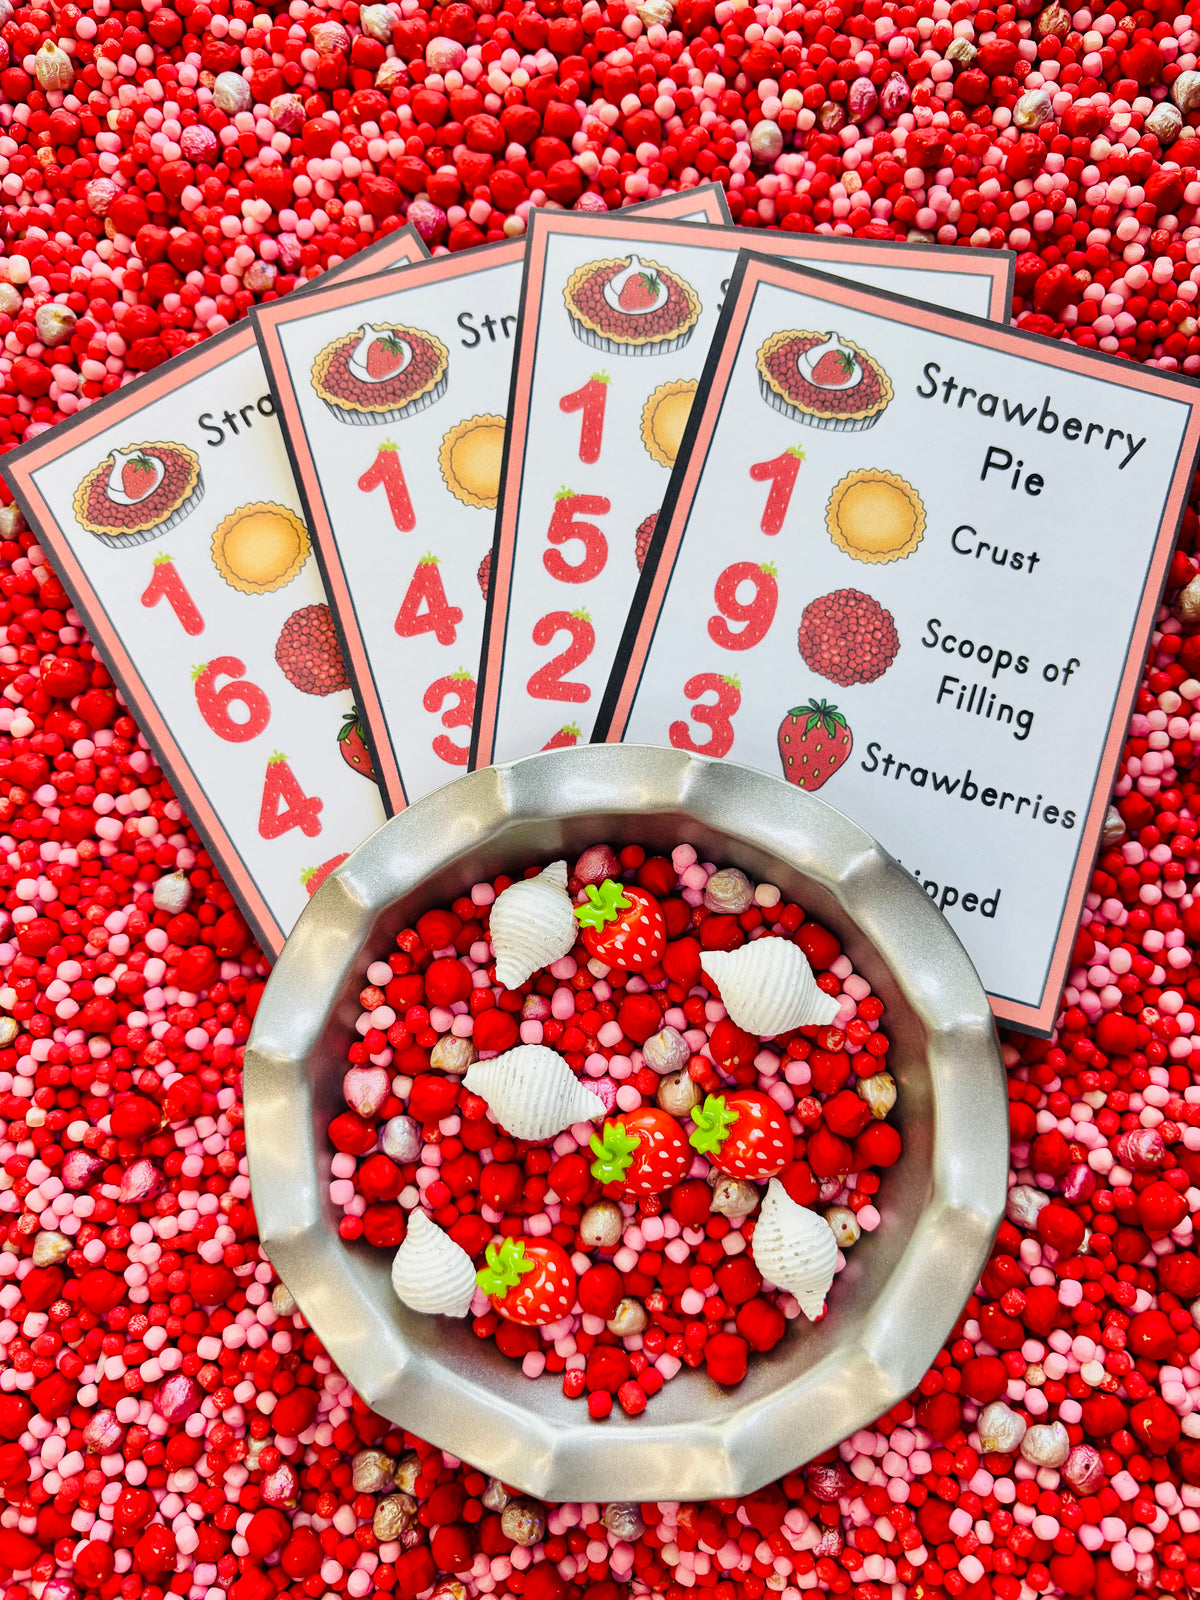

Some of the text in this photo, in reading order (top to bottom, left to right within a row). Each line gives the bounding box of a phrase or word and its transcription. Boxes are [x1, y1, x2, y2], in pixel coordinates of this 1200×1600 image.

[559, 371, 611, 465] 1
[916, 361, 1147, 470] Strawberry
[357, 438, 416, 533] 1
[749, 445, 805, 536] 1
[980, 445, 1045, 497] Pie
[543, 487, 611, 584] 5
[951, 524, 1041, 574] Crust
[141, 551, 205, 637] 1
[394, 551, 463, 646] 4
[707, 561, 779, 651] 9
[526, 607, 596, 704] 2
[921, 618, 1081, 686] Scoops of
[191, 655, 271, 743] 6
[669, 673, 742, 759] 3
[936, 674, 1035, 741] Filling
[258, 750, 324, 840] 4
[860, 741, 1077, 830] Strawberries
